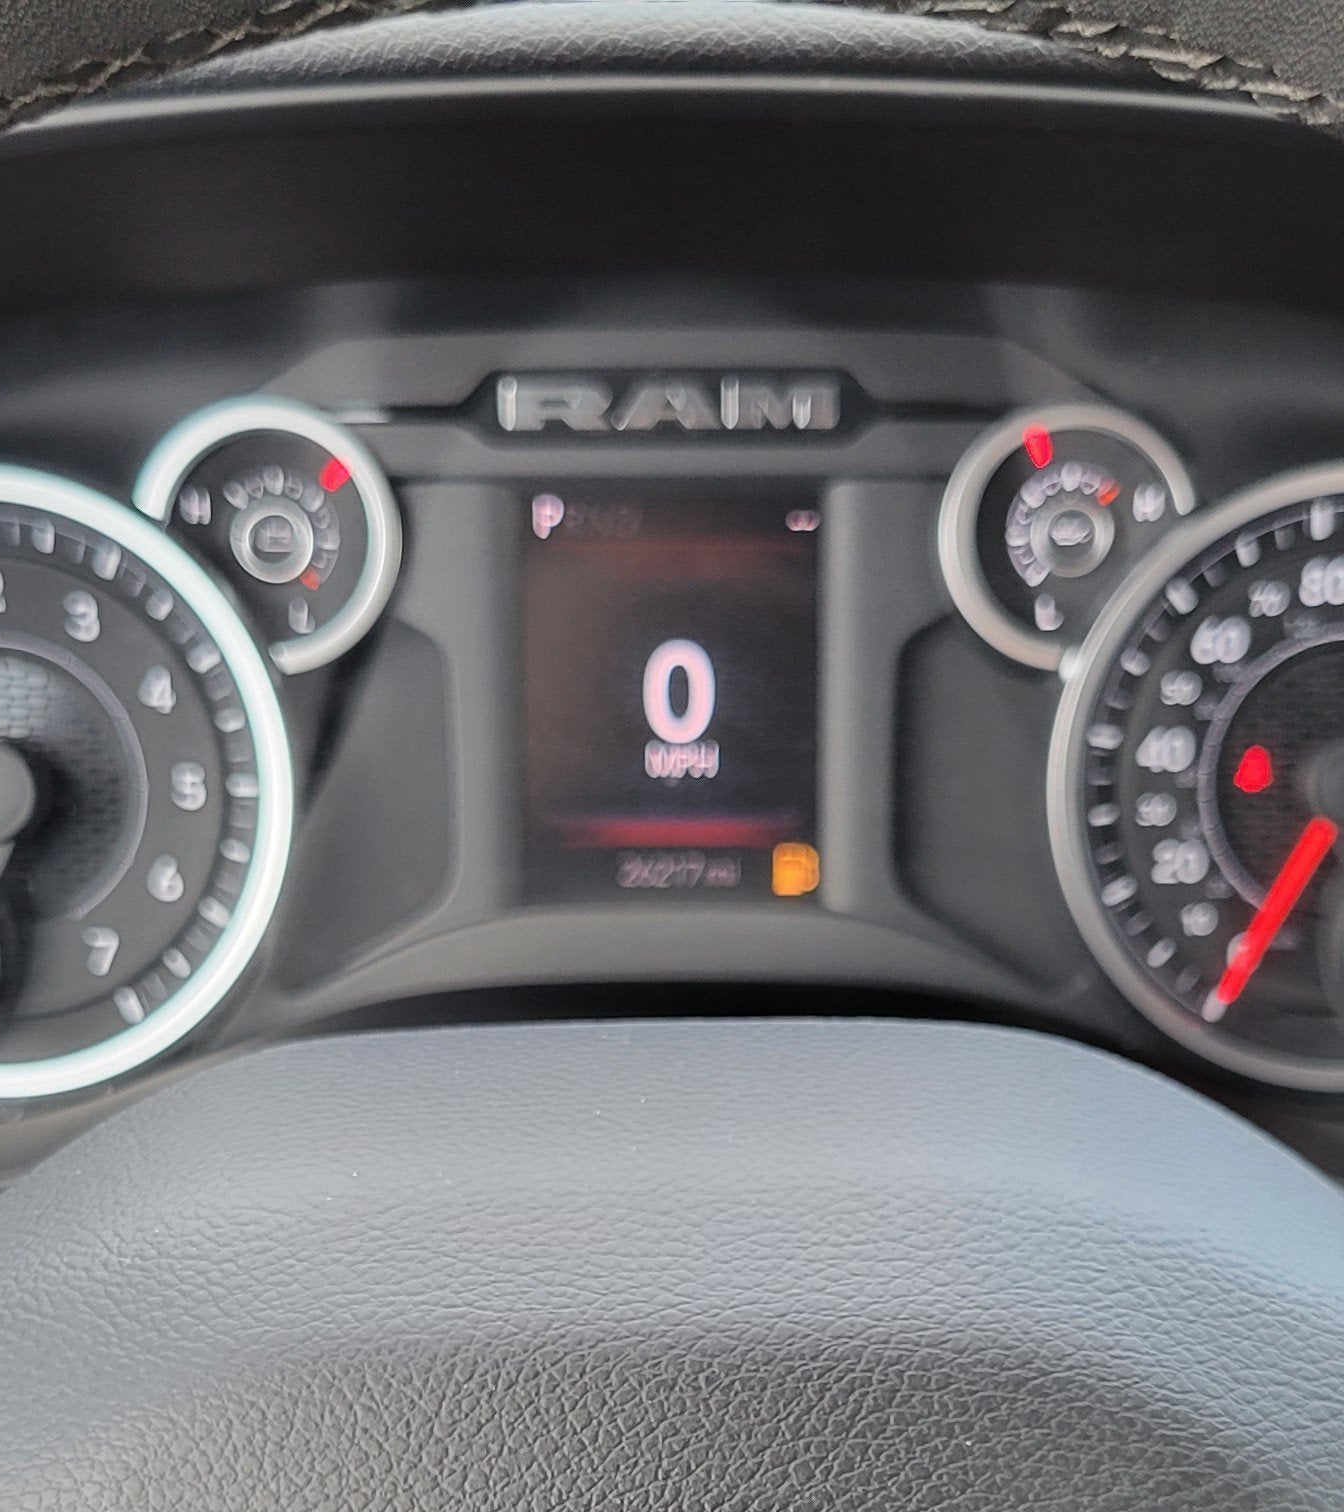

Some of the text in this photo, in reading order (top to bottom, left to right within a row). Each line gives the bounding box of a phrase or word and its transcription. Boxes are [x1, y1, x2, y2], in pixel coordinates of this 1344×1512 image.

[497, 376, 840, 431] RAM
[532, 493, 565, 540] P
[62, 590, 100, 642] 3
[1191, 616, 1252, 664] 60
[139, 664, 176, 715] 4
[643, 639, 715, 743] 0
[644, 740, 719, 777] MPH
[1136, 727, 1197, 772] 40
[170, 761, 207, 811] 5
[146, 855, 184, 902] 6
[1152, 837, 1210, 884] 20
[81, 926, 120, 976] 7
